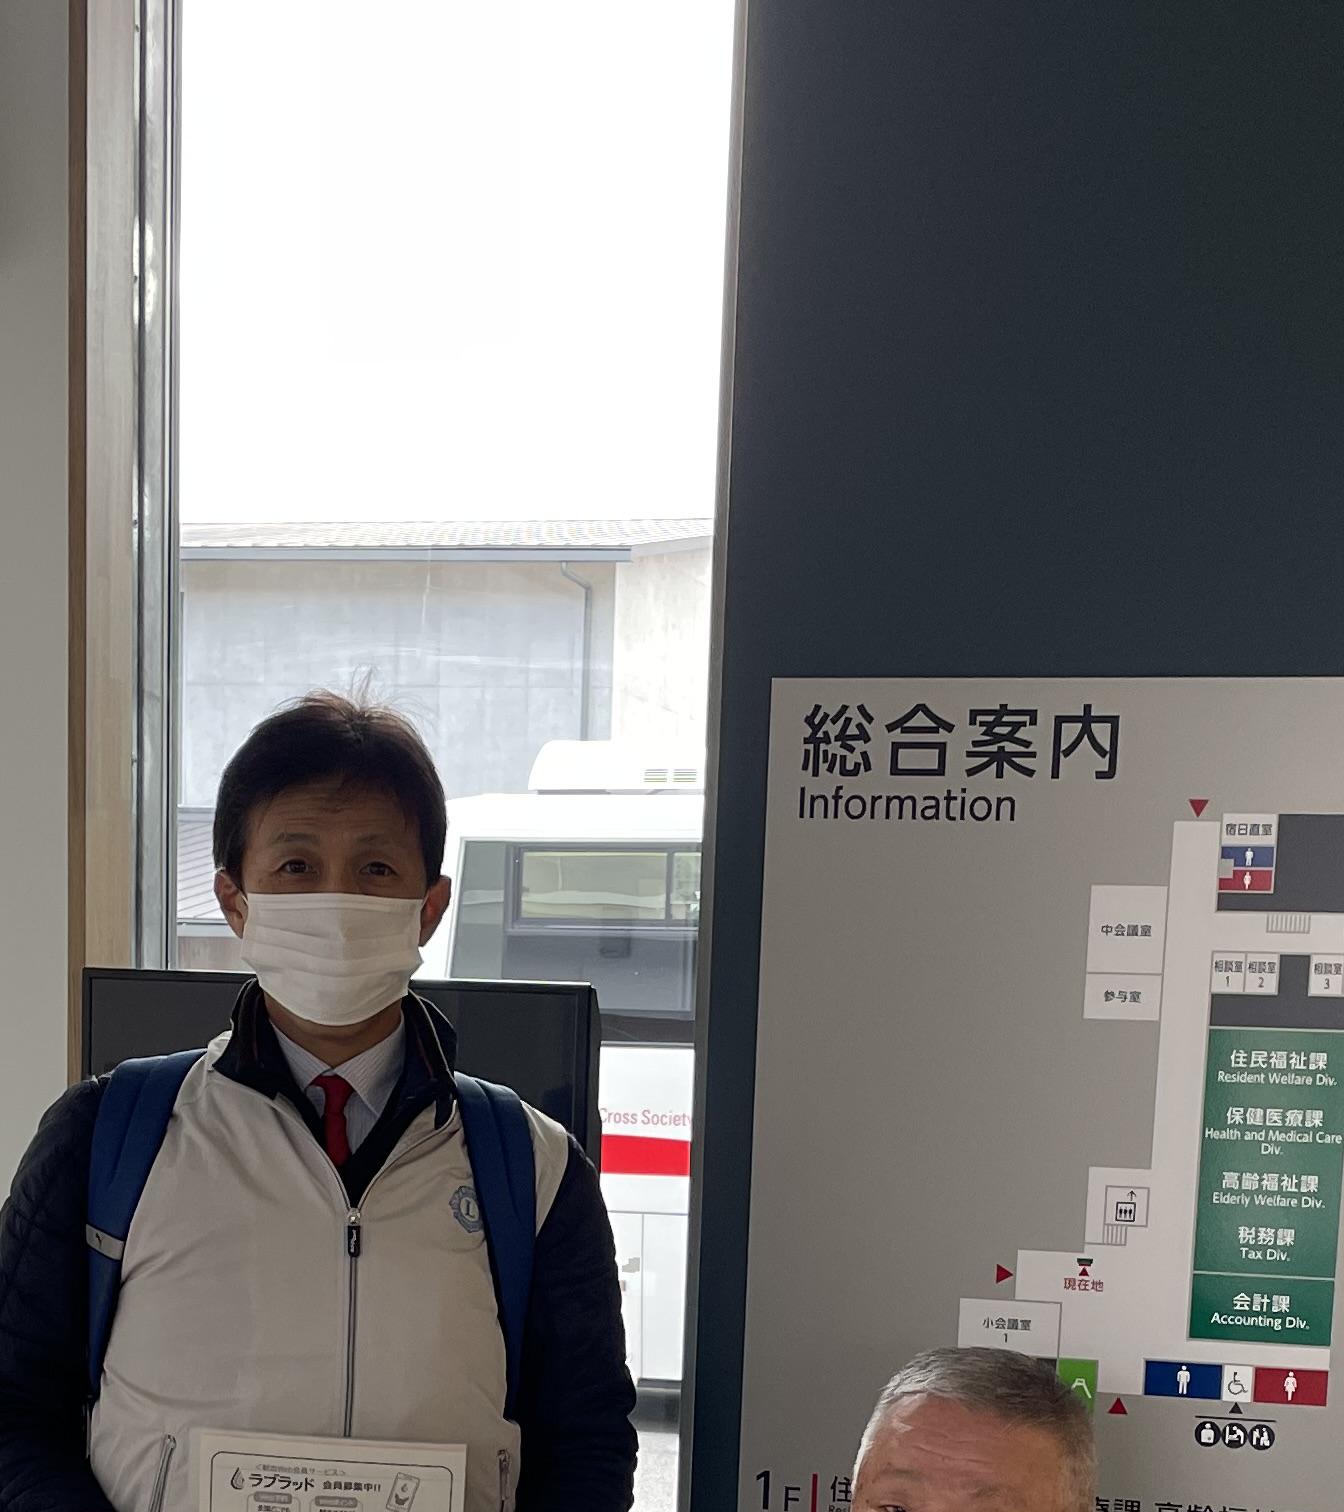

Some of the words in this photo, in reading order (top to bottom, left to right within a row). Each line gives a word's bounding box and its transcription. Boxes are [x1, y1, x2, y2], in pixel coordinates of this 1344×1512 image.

[801, 703, 1121, 780] 総合案内
[797, 787, 1017, 822] Information
[1257, 976, 1266, 990] 2
[1323, 978, 1331, 991] 3
[1230, 1050, 1328, 1070] 住民福祉課
[1226, 1107, 1324, 1128] 保健医療課
[1222, 1172, 1319, 1193] 高齢福祉課
[1238, 1226, 1296, 1246] 税務課
[1240, 1248, 1263, 1260] Tax
[1267, 1249, 1291, 1261] Div.
[1233, 1292, 1290, 1313] 会計課
[1211, 1313, 1282, 1331] Accounting
[1286, 1317, 1310, 1330] Div.
[248, 1472, 316, 1492] ラブラッド
[756, 1470, 801, 1512] 1F
